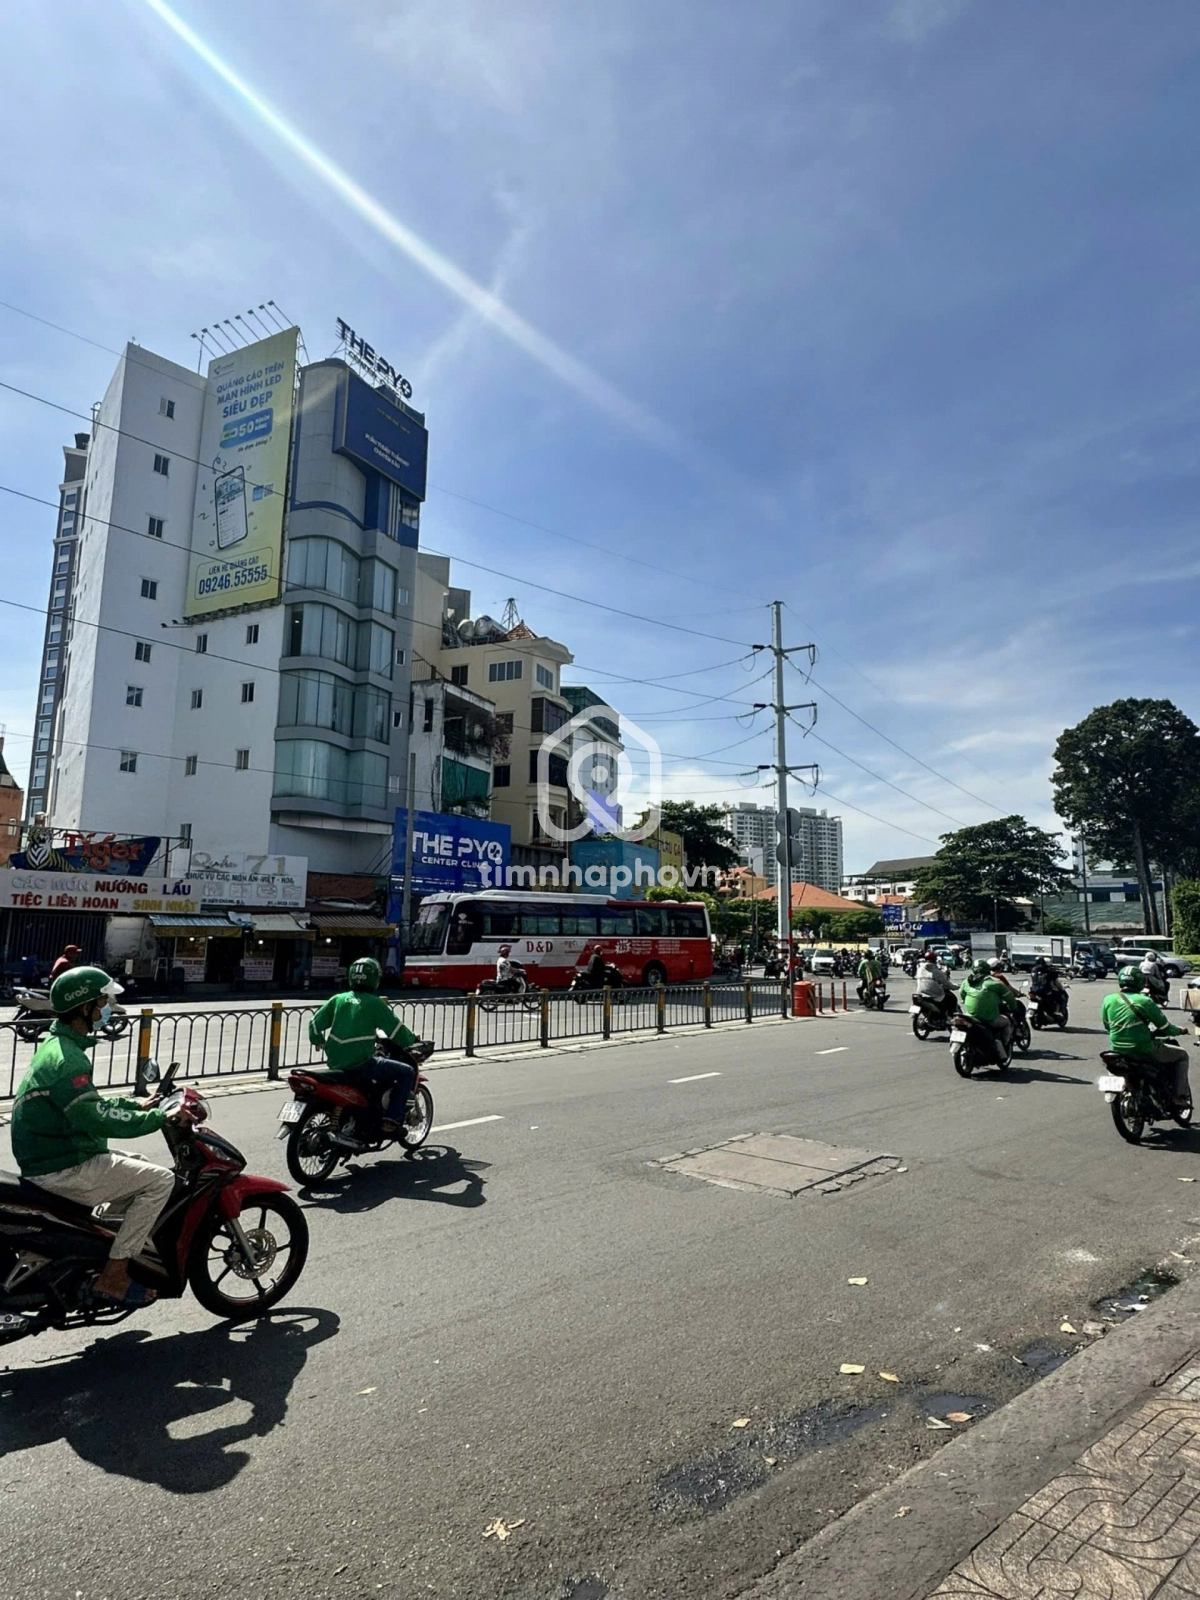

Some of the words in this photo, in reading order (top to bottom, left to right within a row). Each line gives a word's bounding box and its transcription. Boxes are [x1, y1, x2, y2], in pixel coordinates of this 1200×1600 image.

[337, 317, 375, 366] THE
[265, 361, 284, 375] TRÊN
[265, 374, 282, 387] LED
[223, 399, 247, 418] SIÊU
[250, 391, 273, 407] ĐẸP
[239, 420, 255, 437] 50
[198, 564, 268, 595] 09246.55555
[63, 832, 145, 870] Tiger
[412, 831, 453, 857] THE
[246, 855, 286, 875] 71
[421, 856, 458, 867] CENTER
[11, 874, 46, 890] CÁC
[50, 875, 89, 891] MÓN
[94, 878, 149, 894] NƯỚNG
[11, 891, 43, 907] TIỆC
[47, 893, 77, 907] LIÊN
[82, 896, 119, 910] HOAN
[133, 899, 163, 911] SINH
[526, 941, 554, 953] D&D
[351, 972, 368, 980] Grab
[64, 986, 90, 1002] Grab
